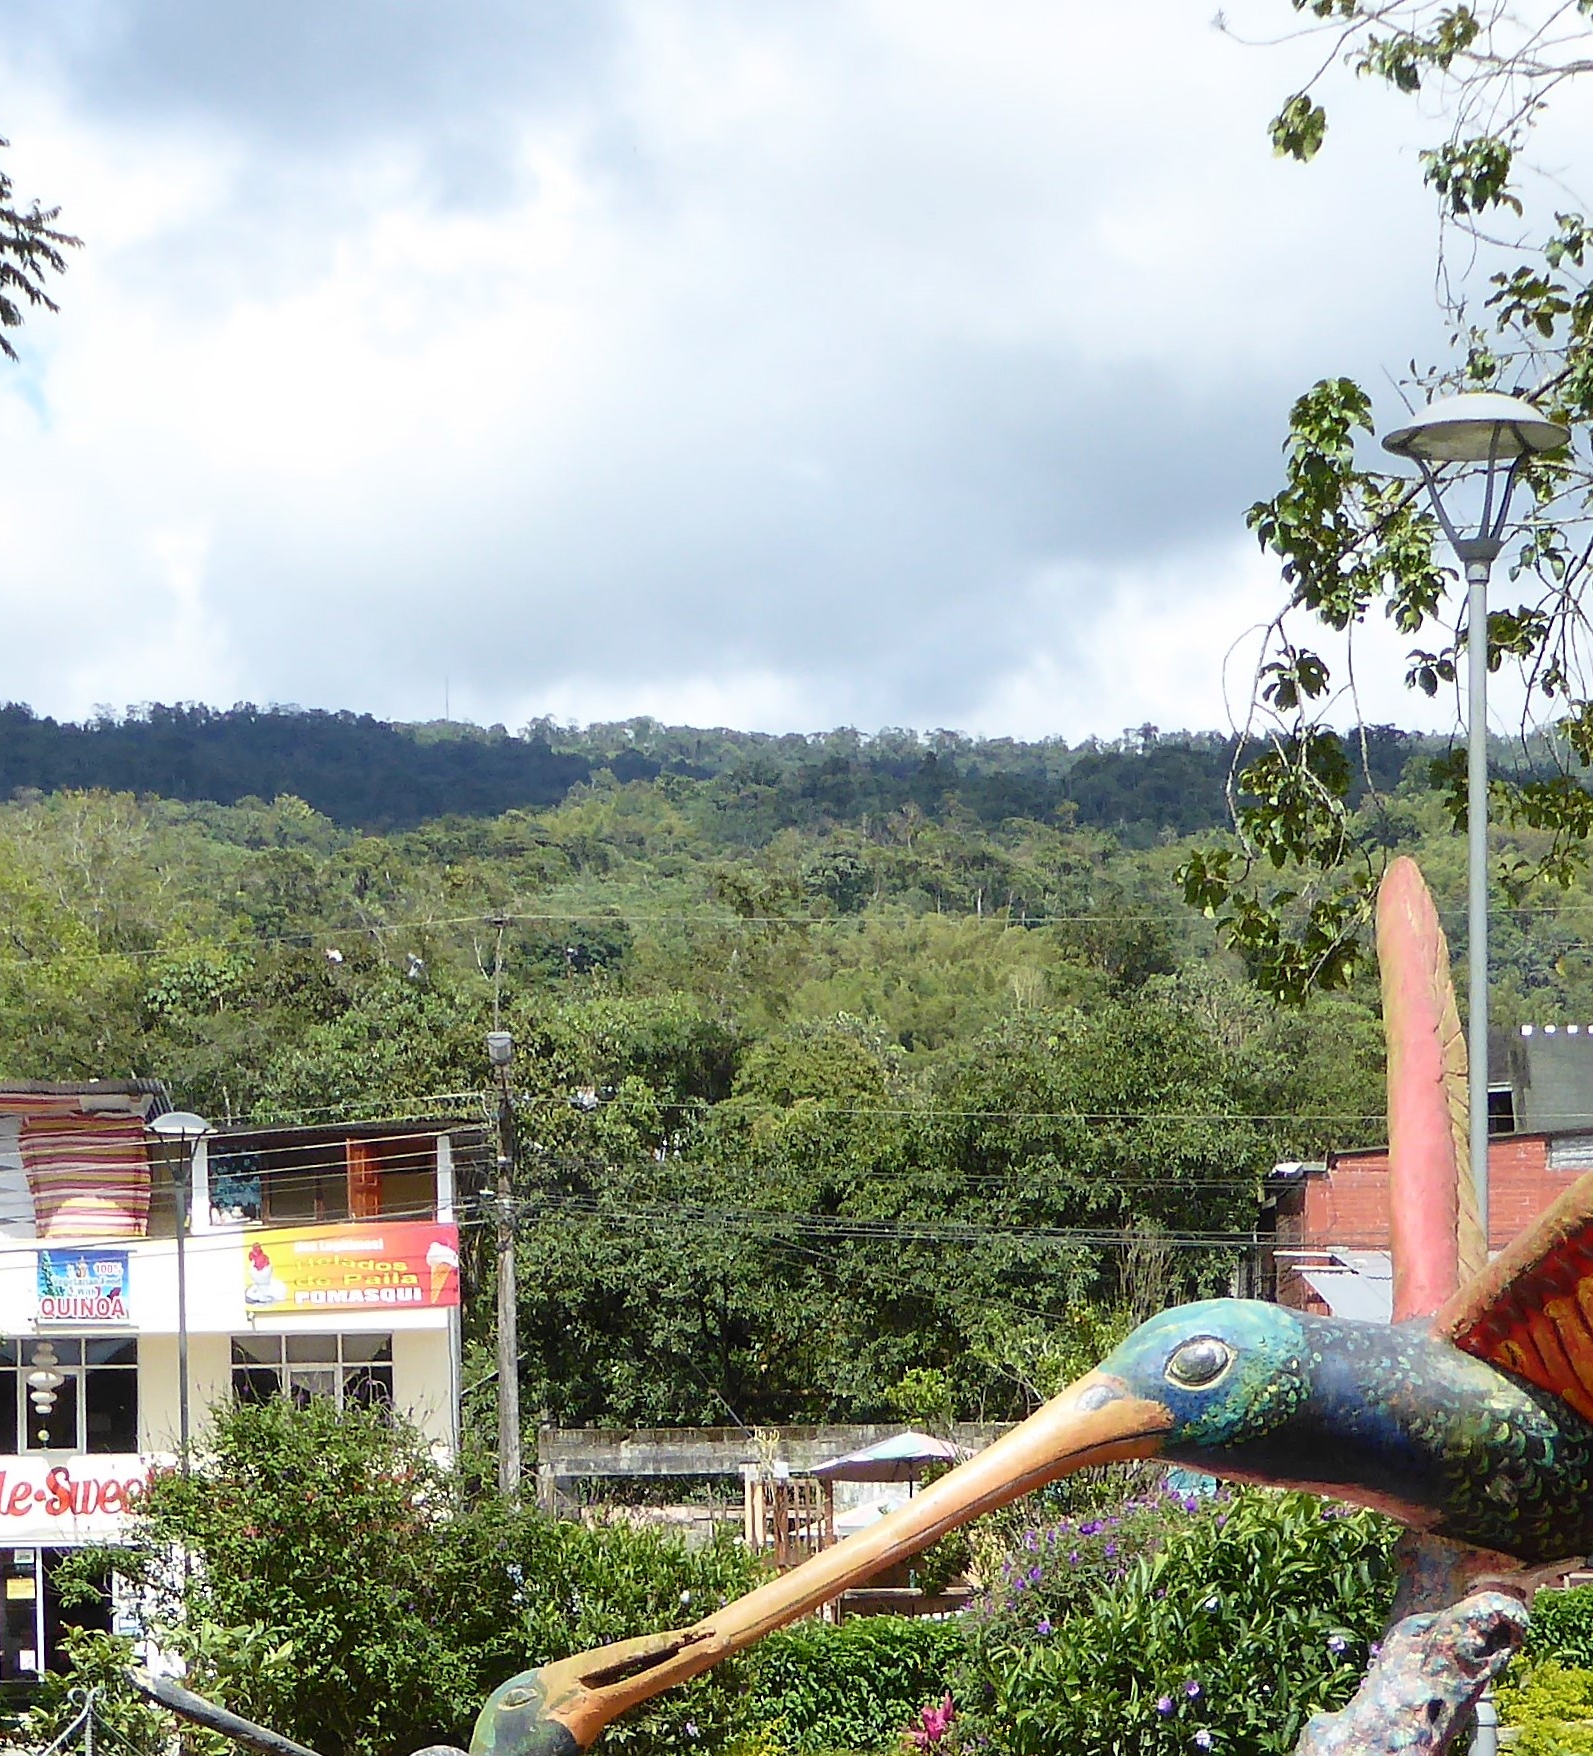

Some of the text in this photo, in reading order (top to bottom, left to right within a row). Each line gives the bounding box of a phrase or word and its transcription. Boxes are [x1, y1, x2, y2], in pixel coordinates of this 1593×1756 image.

[343, 1272, 419, 1286] Paila
[294, 1287, 423, 1304] POMASQUI
[41, 1297, 126, 1317] QUINOA
